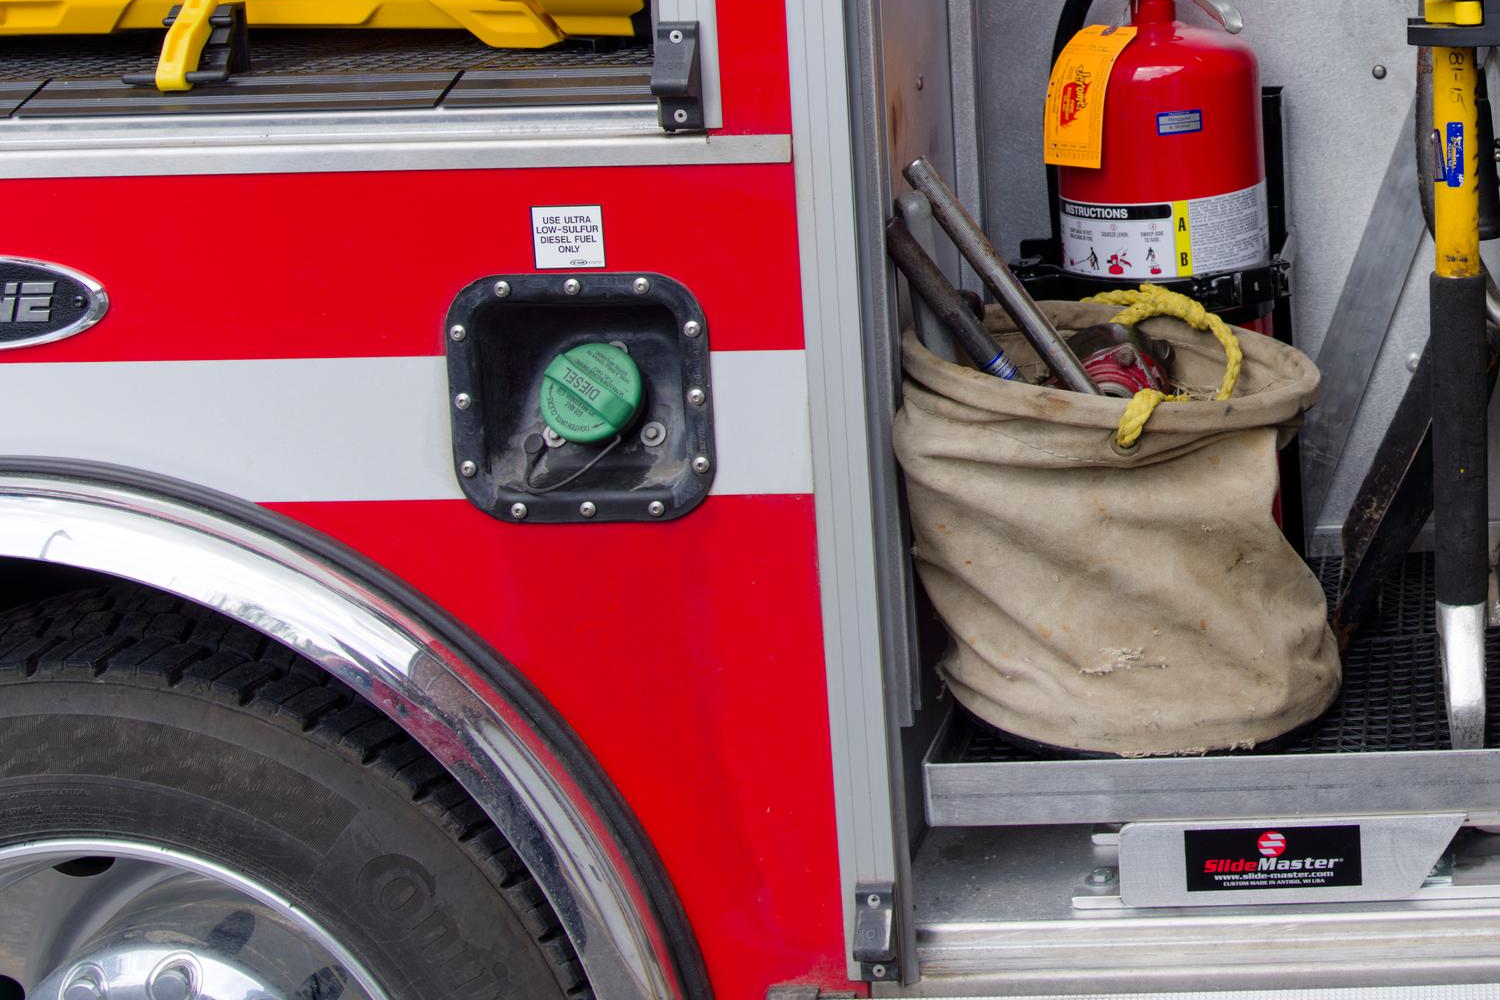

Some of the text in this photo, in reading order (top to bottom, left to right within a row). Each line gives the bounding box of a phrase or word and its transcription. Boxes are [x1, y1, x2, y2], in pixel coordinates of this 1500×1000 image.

[1074, 64, 1092, 109] Jerome
[1065, 203, 1128, 219] INSTRUCTIONS
[542, 216, 592, 224] USE ULTRA
[1178, 217, 1186, 232] A
[536, 225, 599, 234] LOW-SULFUR
[540, 236, 572, 244] DIESEL
[1180, 252, 1188, 266] B
[563, 366, 601, 401] DIESEL
[1204, 857, 1338, 873] SlideMaster
[1214, 870, 1334, 881] www.slide-master.com
